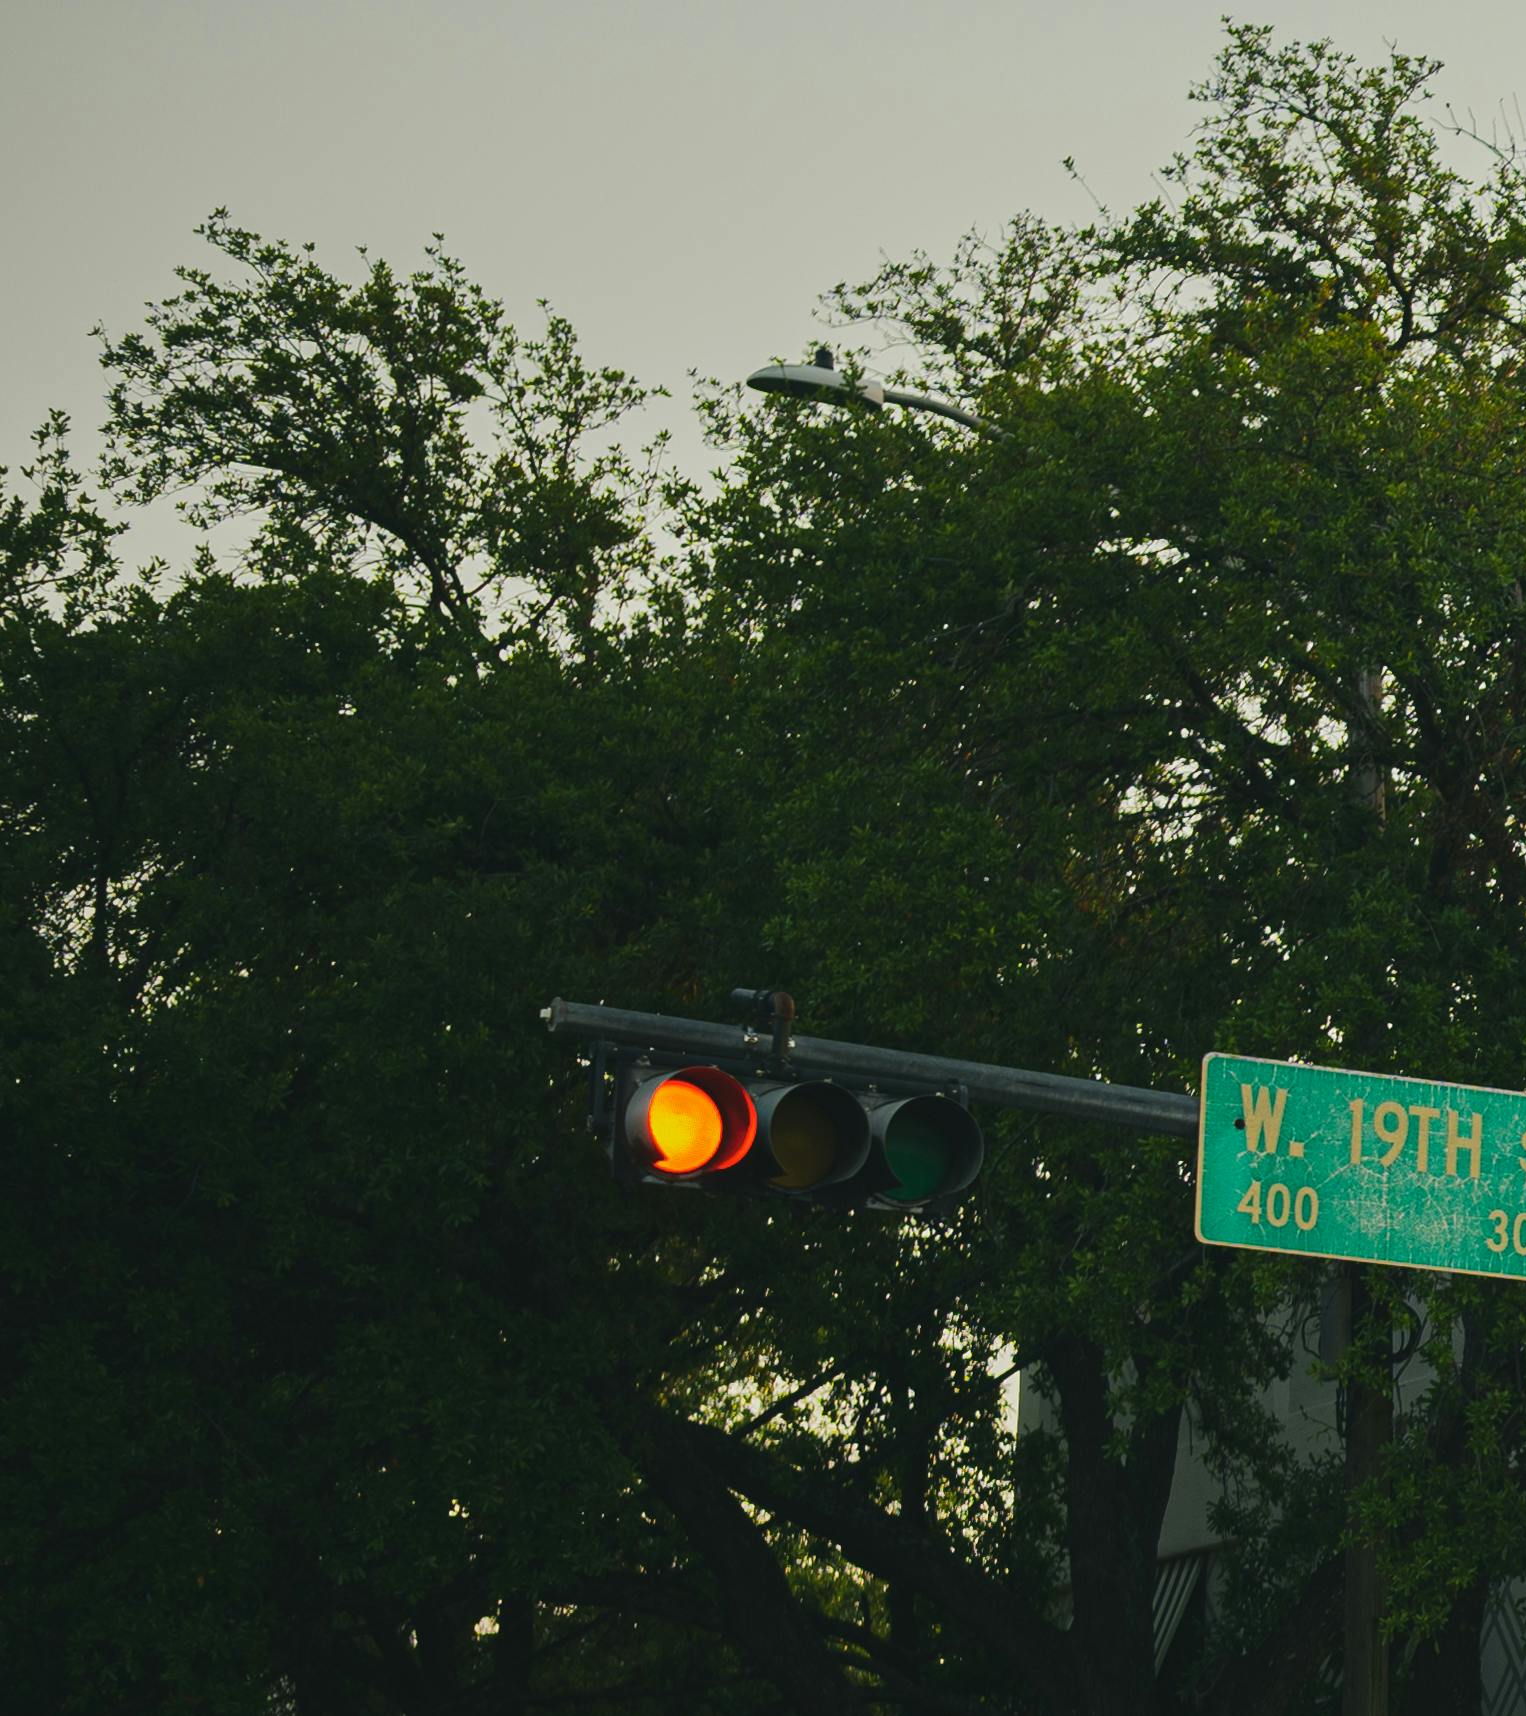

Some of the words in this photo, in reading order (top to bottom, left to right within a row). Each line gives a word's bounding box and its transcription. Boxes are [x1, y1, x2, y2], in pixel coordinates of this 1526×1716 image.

[1241, 1083, 1304, 1158] W.
[1349, 1098, 1483, 1179] 19TH
[1236, 1180, 1319, 1231] 400
